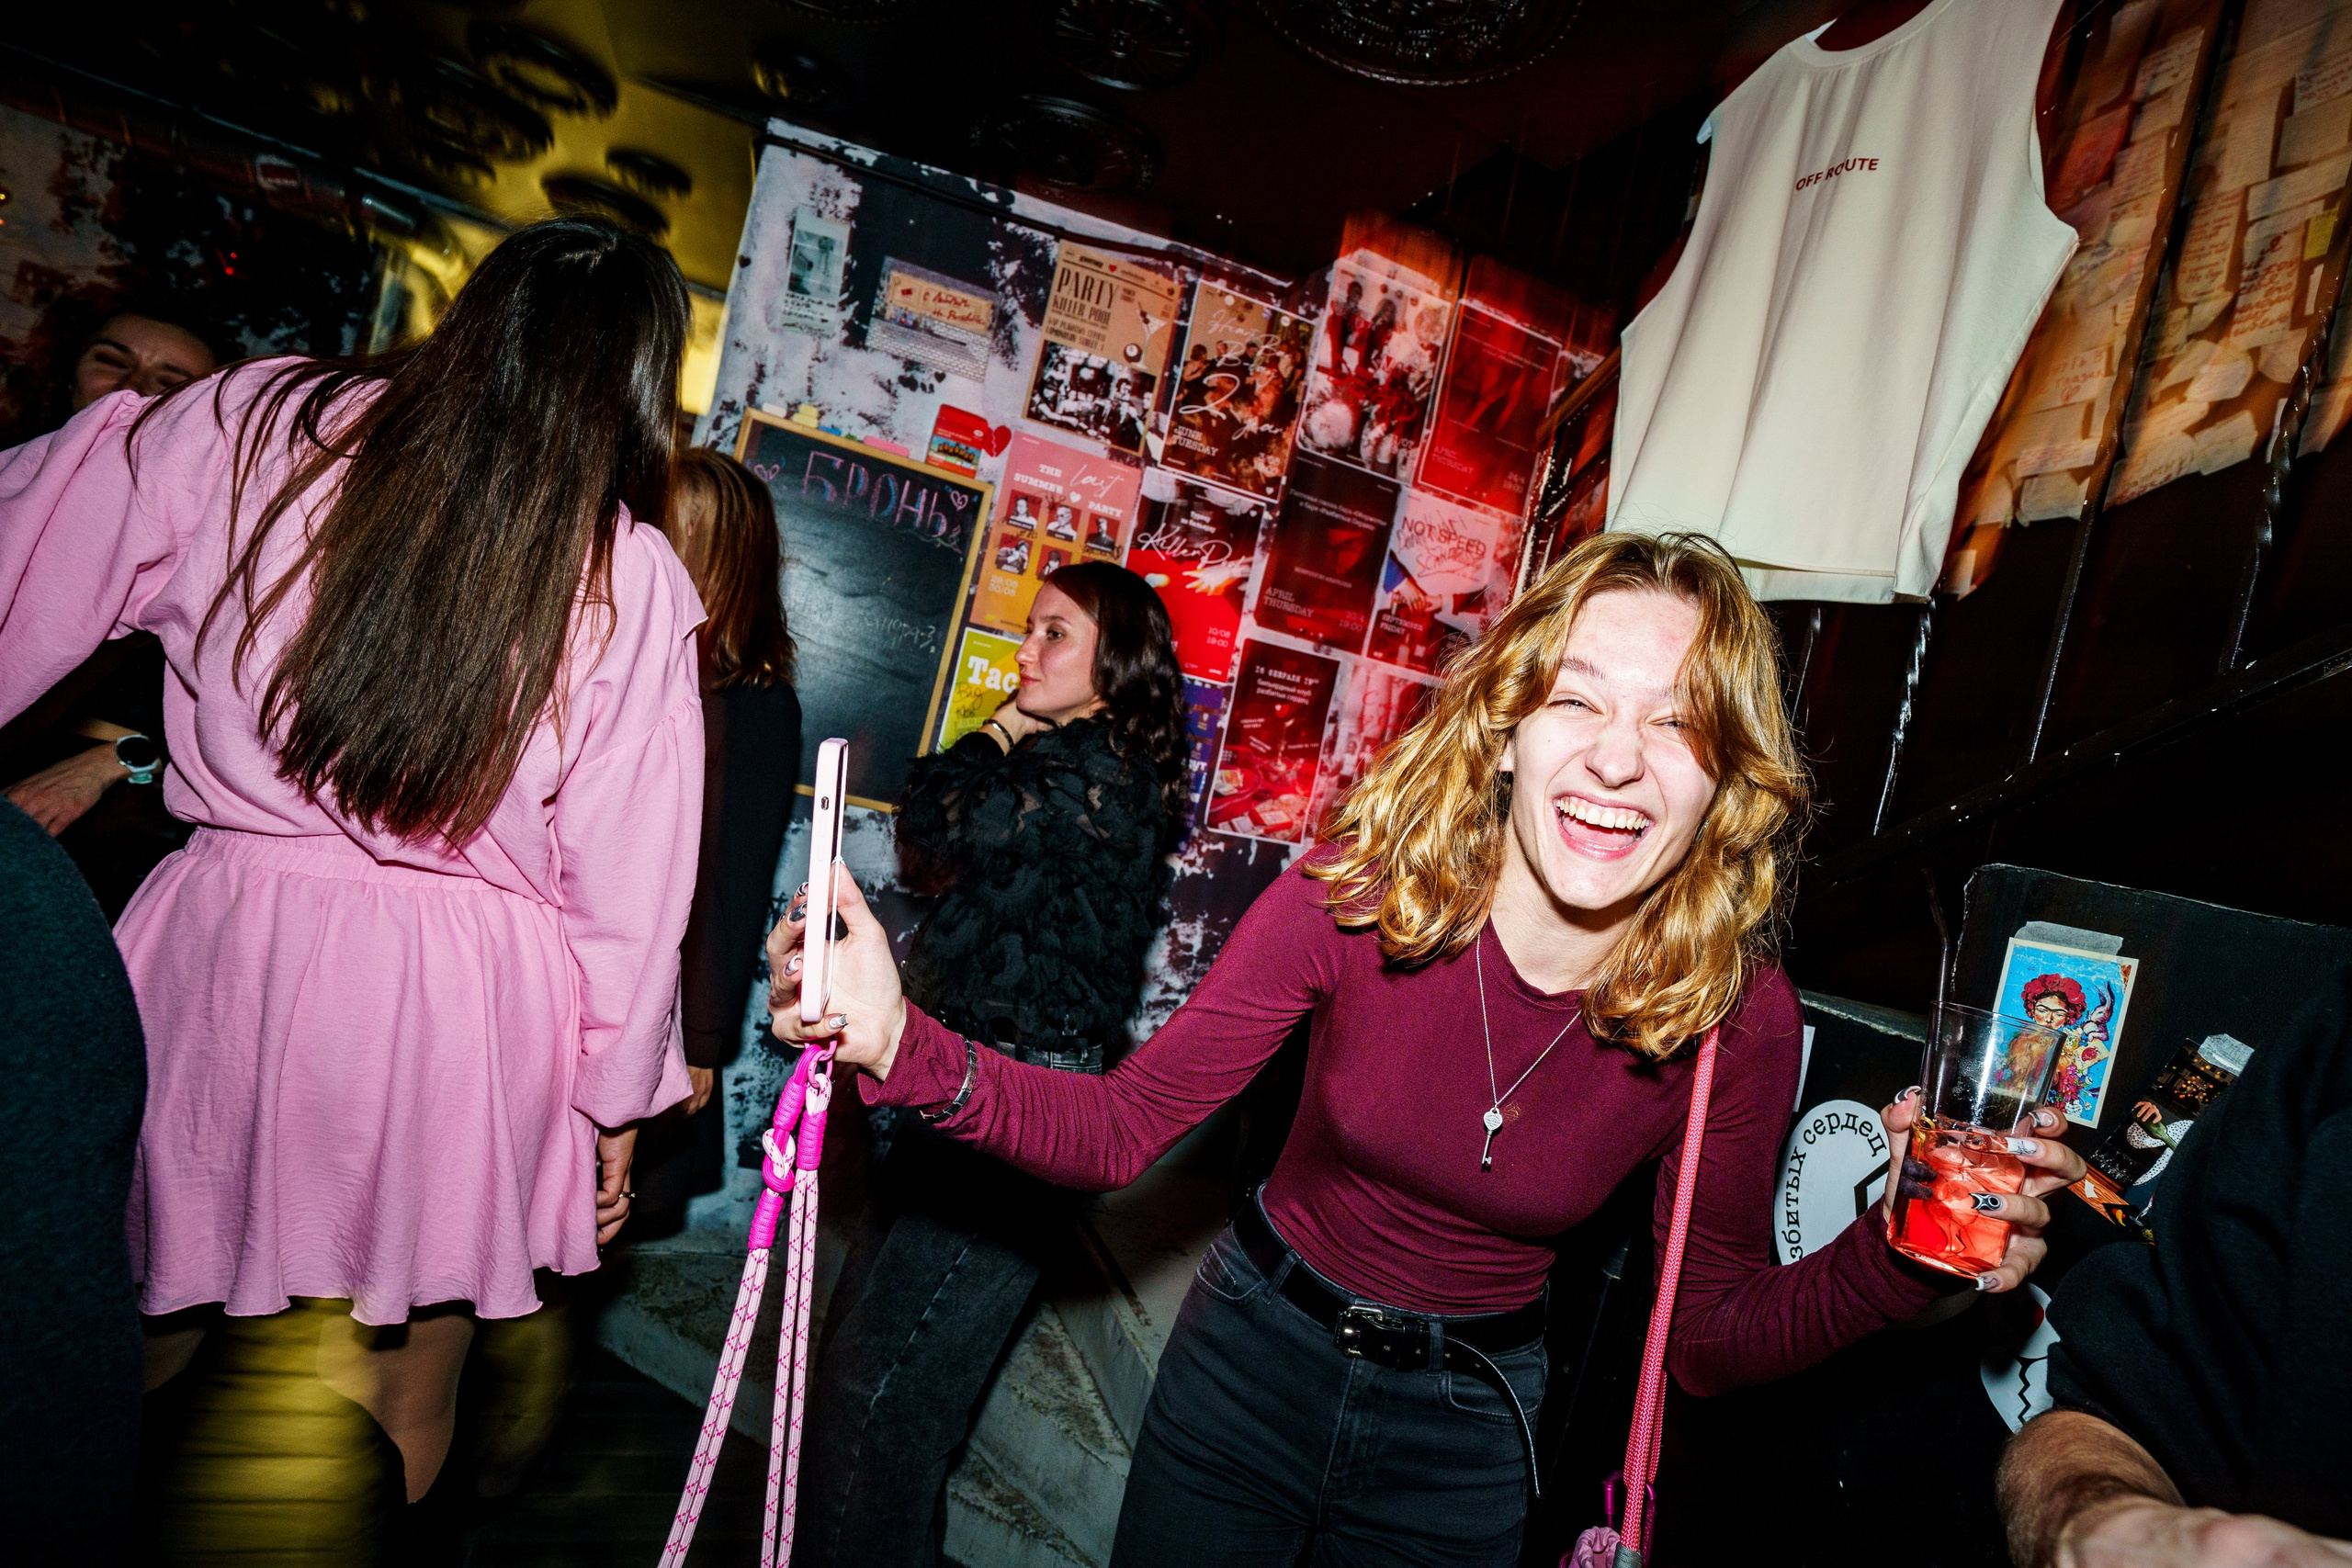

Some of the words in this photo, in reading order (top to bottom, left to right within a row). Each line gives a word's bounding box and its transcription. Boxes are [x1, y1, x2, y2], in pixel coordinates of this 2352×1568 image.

[1795, 171, 1823, 191] OFF
[1825, 157, 1879, 181] ROUTE
[1057, 267, 1119, 309] PARTY
[1178, 372, 1240, 420] 2
[1173, 425, 1204, 442] JUNE
[1172, 434, 1219, 457] TUESDAY
[1038, 464, 1063, 478] THE
[801, 450, 947, 538] БРОНЬ
[1013, 472, 1064, 494] SUMMER
[1088, 501, 1124, 517] PARTY
[1401, 516, 1436, 538] NOT
[1438, 528, 1487, 558] SPEED
[1263, 596, 1314, 617] THURSDAY
[1265, 587, 1295, 603] APRIL
[1803, 1112, 1888, 1157] сердец
